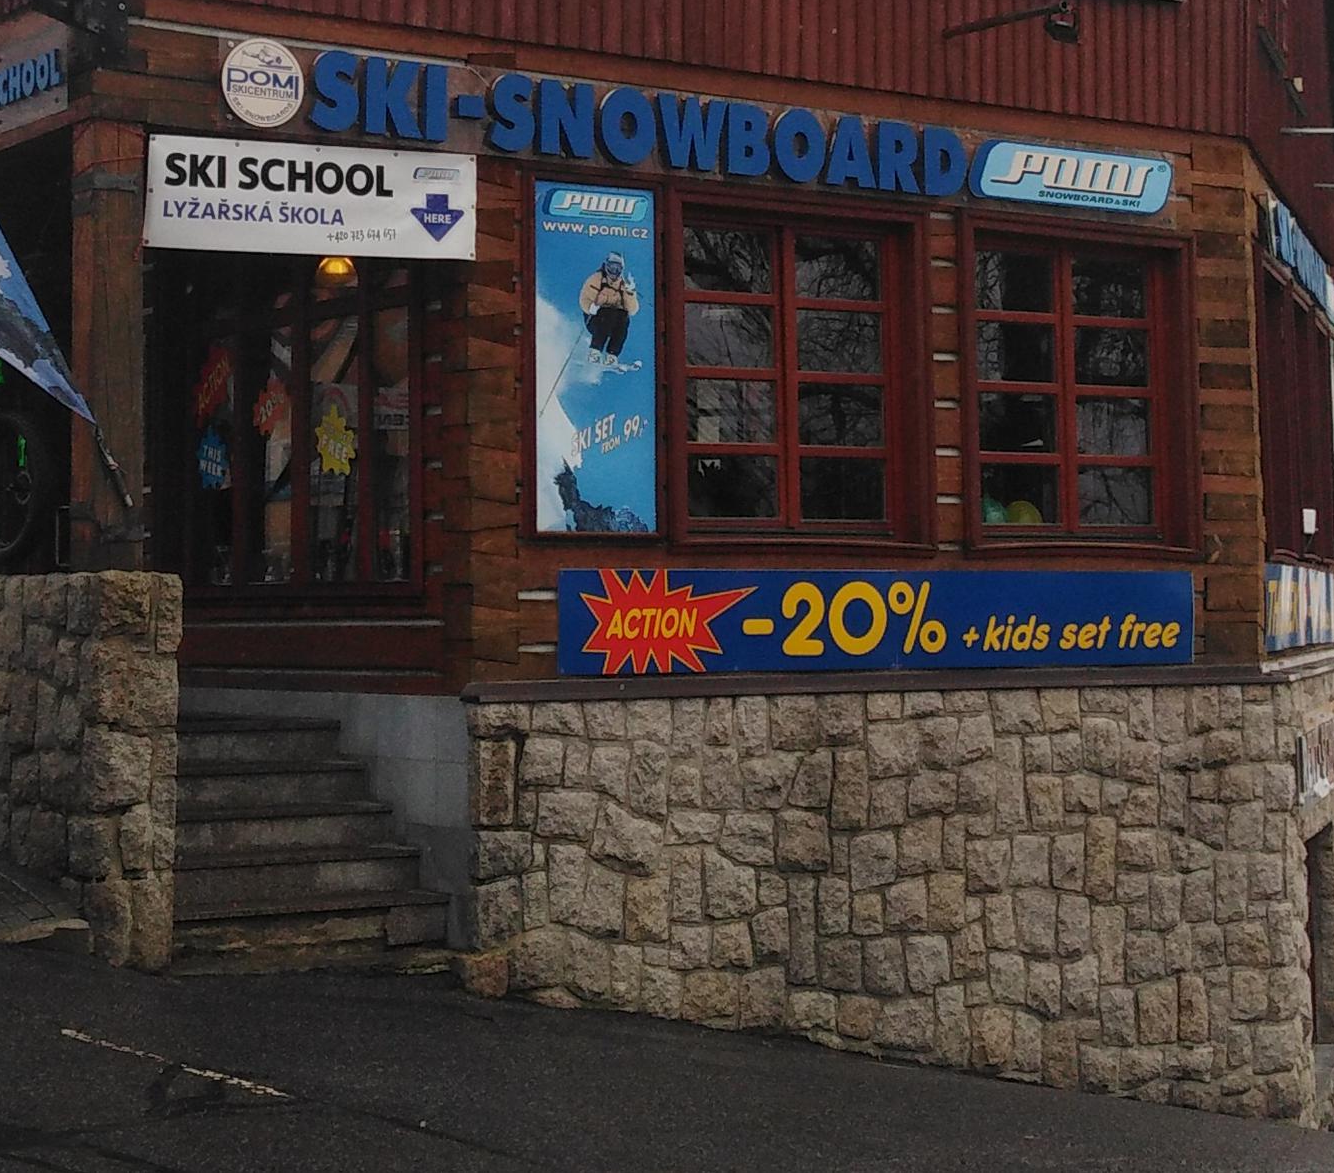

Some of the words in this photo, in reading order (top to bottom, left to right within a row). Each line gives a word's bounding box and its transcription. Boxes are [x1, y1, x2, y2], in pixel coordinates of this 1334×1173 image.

[227, 68, 300, 100] POMI
[232, 84, 294, 100] SKICENTRUM
[308, 50, 967, 198] SKI-SNOWBOARD
[164, 152, 226, 188] SKI
[238, 157, 393, 198] SCHOOL
[163, 196, 273, 223] LYŽAŘSKÁ
[279, 201, 345, 226] ŠKOLA
[424, 213, 452, 224] HERE
[543, 220, 648, 239] www.pomi.cz
[571, 427, 591, 457] SKI
[595, 413, 616, 444] SET
[602, 435, 621, 455] FROM
[200, 459, 223, 477] WEEK
[203, 444, 222, 462] THIS
[604, 606, 698, 641] ACTION
[743, 580, 947, 656] -20%
[1060, 615, 1111, 650] set
[1119, 614, 1181, 650] free
